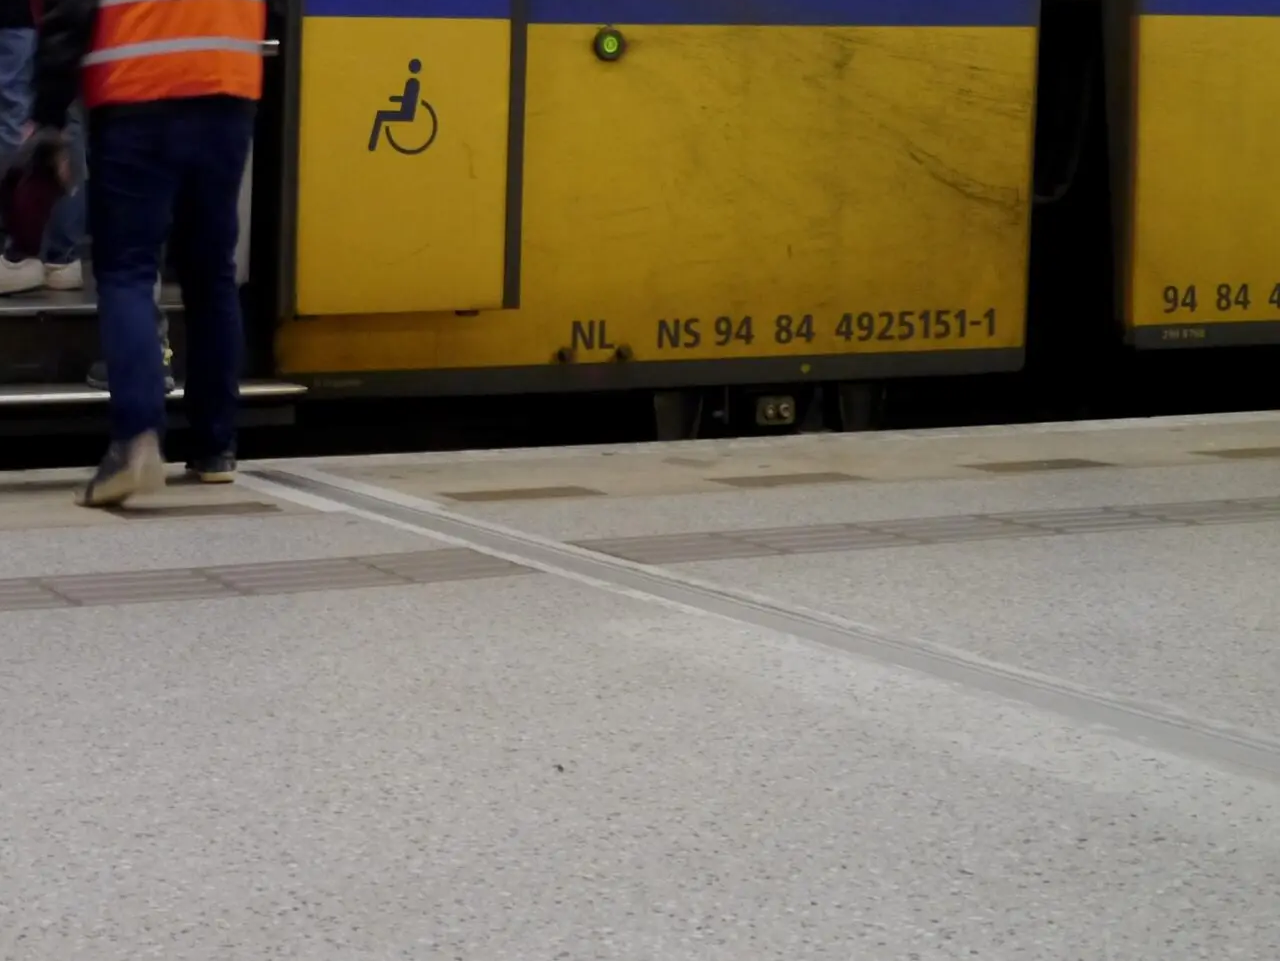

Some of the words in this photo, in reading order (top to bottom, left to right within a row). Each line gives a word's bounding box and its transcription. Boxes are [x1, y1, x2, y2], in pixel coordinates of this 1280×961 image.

[1163, 285, 1198, 313] 94
[1216, 283, 1251, 311] 84
[571, 320, 615, 350] NL
[656, 317, 701, 349] NS
[713, 315, 755, 346] 94
[774, 313, 816, 344] 84
[834, 308, 997, 342] 4925151-1
